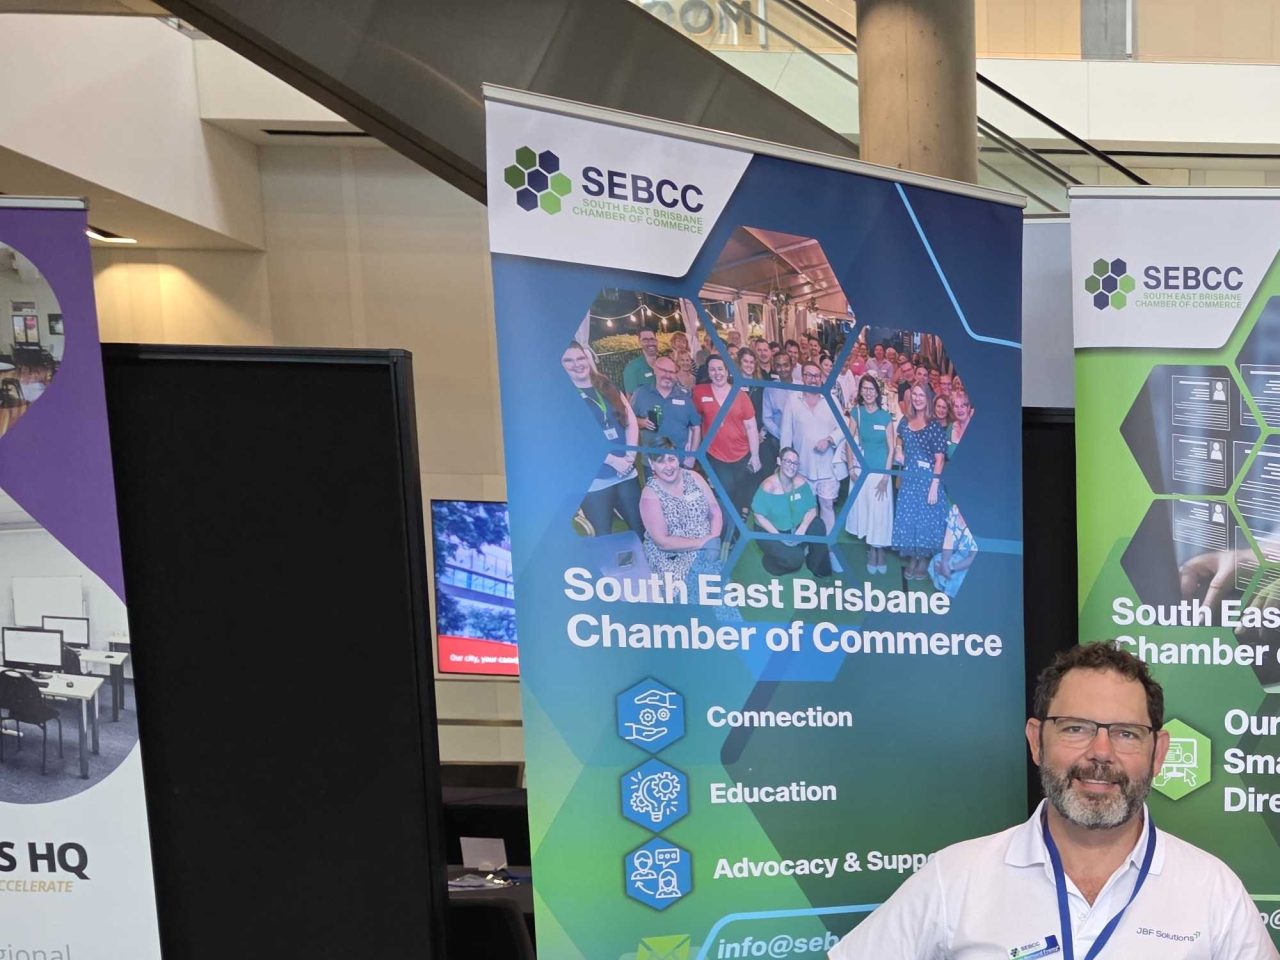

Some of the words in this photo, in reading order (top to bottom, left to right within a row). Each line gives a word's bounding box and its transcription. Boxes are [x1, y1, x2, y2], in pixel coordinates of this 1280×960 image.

[582, 166, 704, 213] SEBCC
[572, 206, 626, 221] CHAMBER
[628, 215, 644, 223] OF
[646, 217, 703, 235] COMMERCE
[583, 199, 620, 211] SOUTH
[623, 204, 652, 216] EAST
[653, 209, 703, 225] BRISBANE
[1143, 265, 1243, 291] SEBCC
[1135, 300, 1177, 308] CHAMBER
[1192, 301, 1241, 309] COMMERCE
[1143, 292, 1174, 300] SOUTH
[1175, 292, 1197, 300] EAST
[1199, 293, 1241, 301] BRISBANE
[563, 566, 689, 605] South
[698, 573, 785, 609] East
[793, 578, 950, 616] Brisbane
[1112, 597, 1212, 627] South
[566, 613, 756, 651] Chamber
[765, 617, 804, 652] of
[812, 621, 1003, 657] Commerce
[706, 705, 854, 728] Connection
[710, 781, 837, 804] Education
[28, 842, 91, 880] HQ
[713, 857, 838, 879] Advocacy
[843, 852, 862, 872] &
[1136, 927, 1155, 936] JBF
[1156, 930, 1195, 942] Solutions
